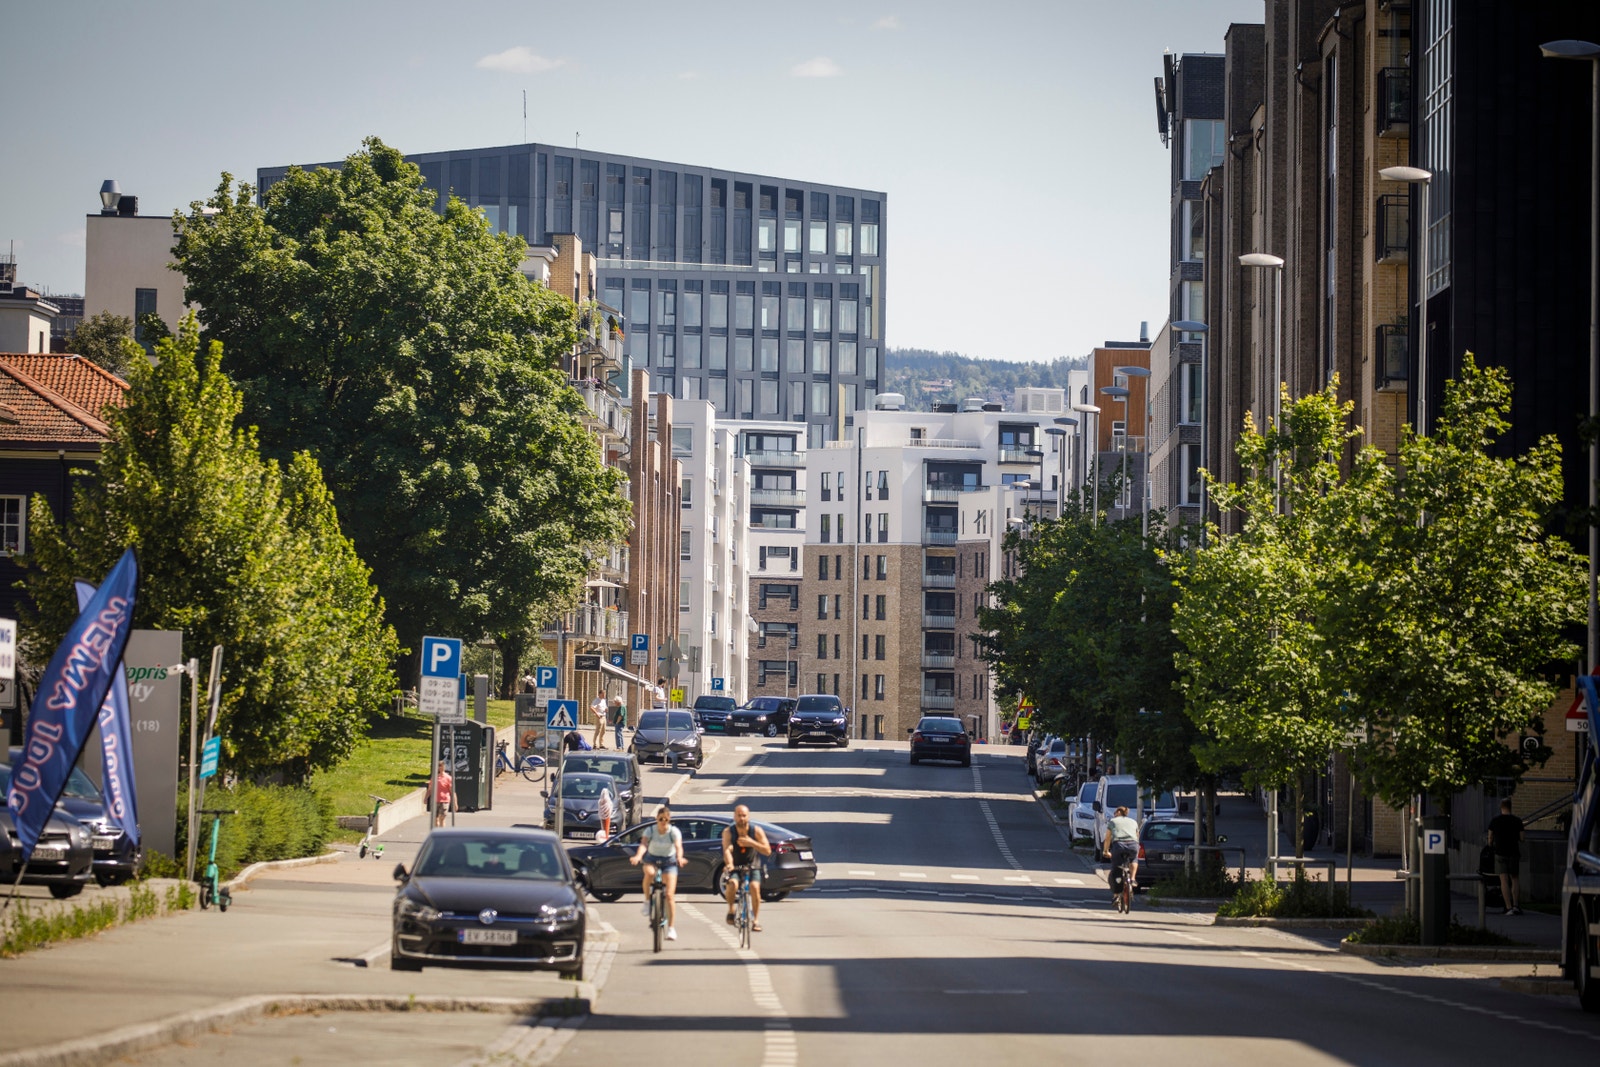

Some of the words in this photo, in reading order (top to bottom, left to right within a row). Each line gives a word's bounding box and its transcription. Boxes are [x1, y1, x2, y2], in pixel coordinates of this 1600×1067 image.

[635, 636, 645, 648] P
[430, 643, 452, 672] P
[126, 664, 168, 683] opris
[541, 669, 553, 686] P
[128, 683, 154, 702] ity
[714, 680, 721, 689] P
[137, 720, 160, 732] (18)
[1429, 834, 1441, 849] P
